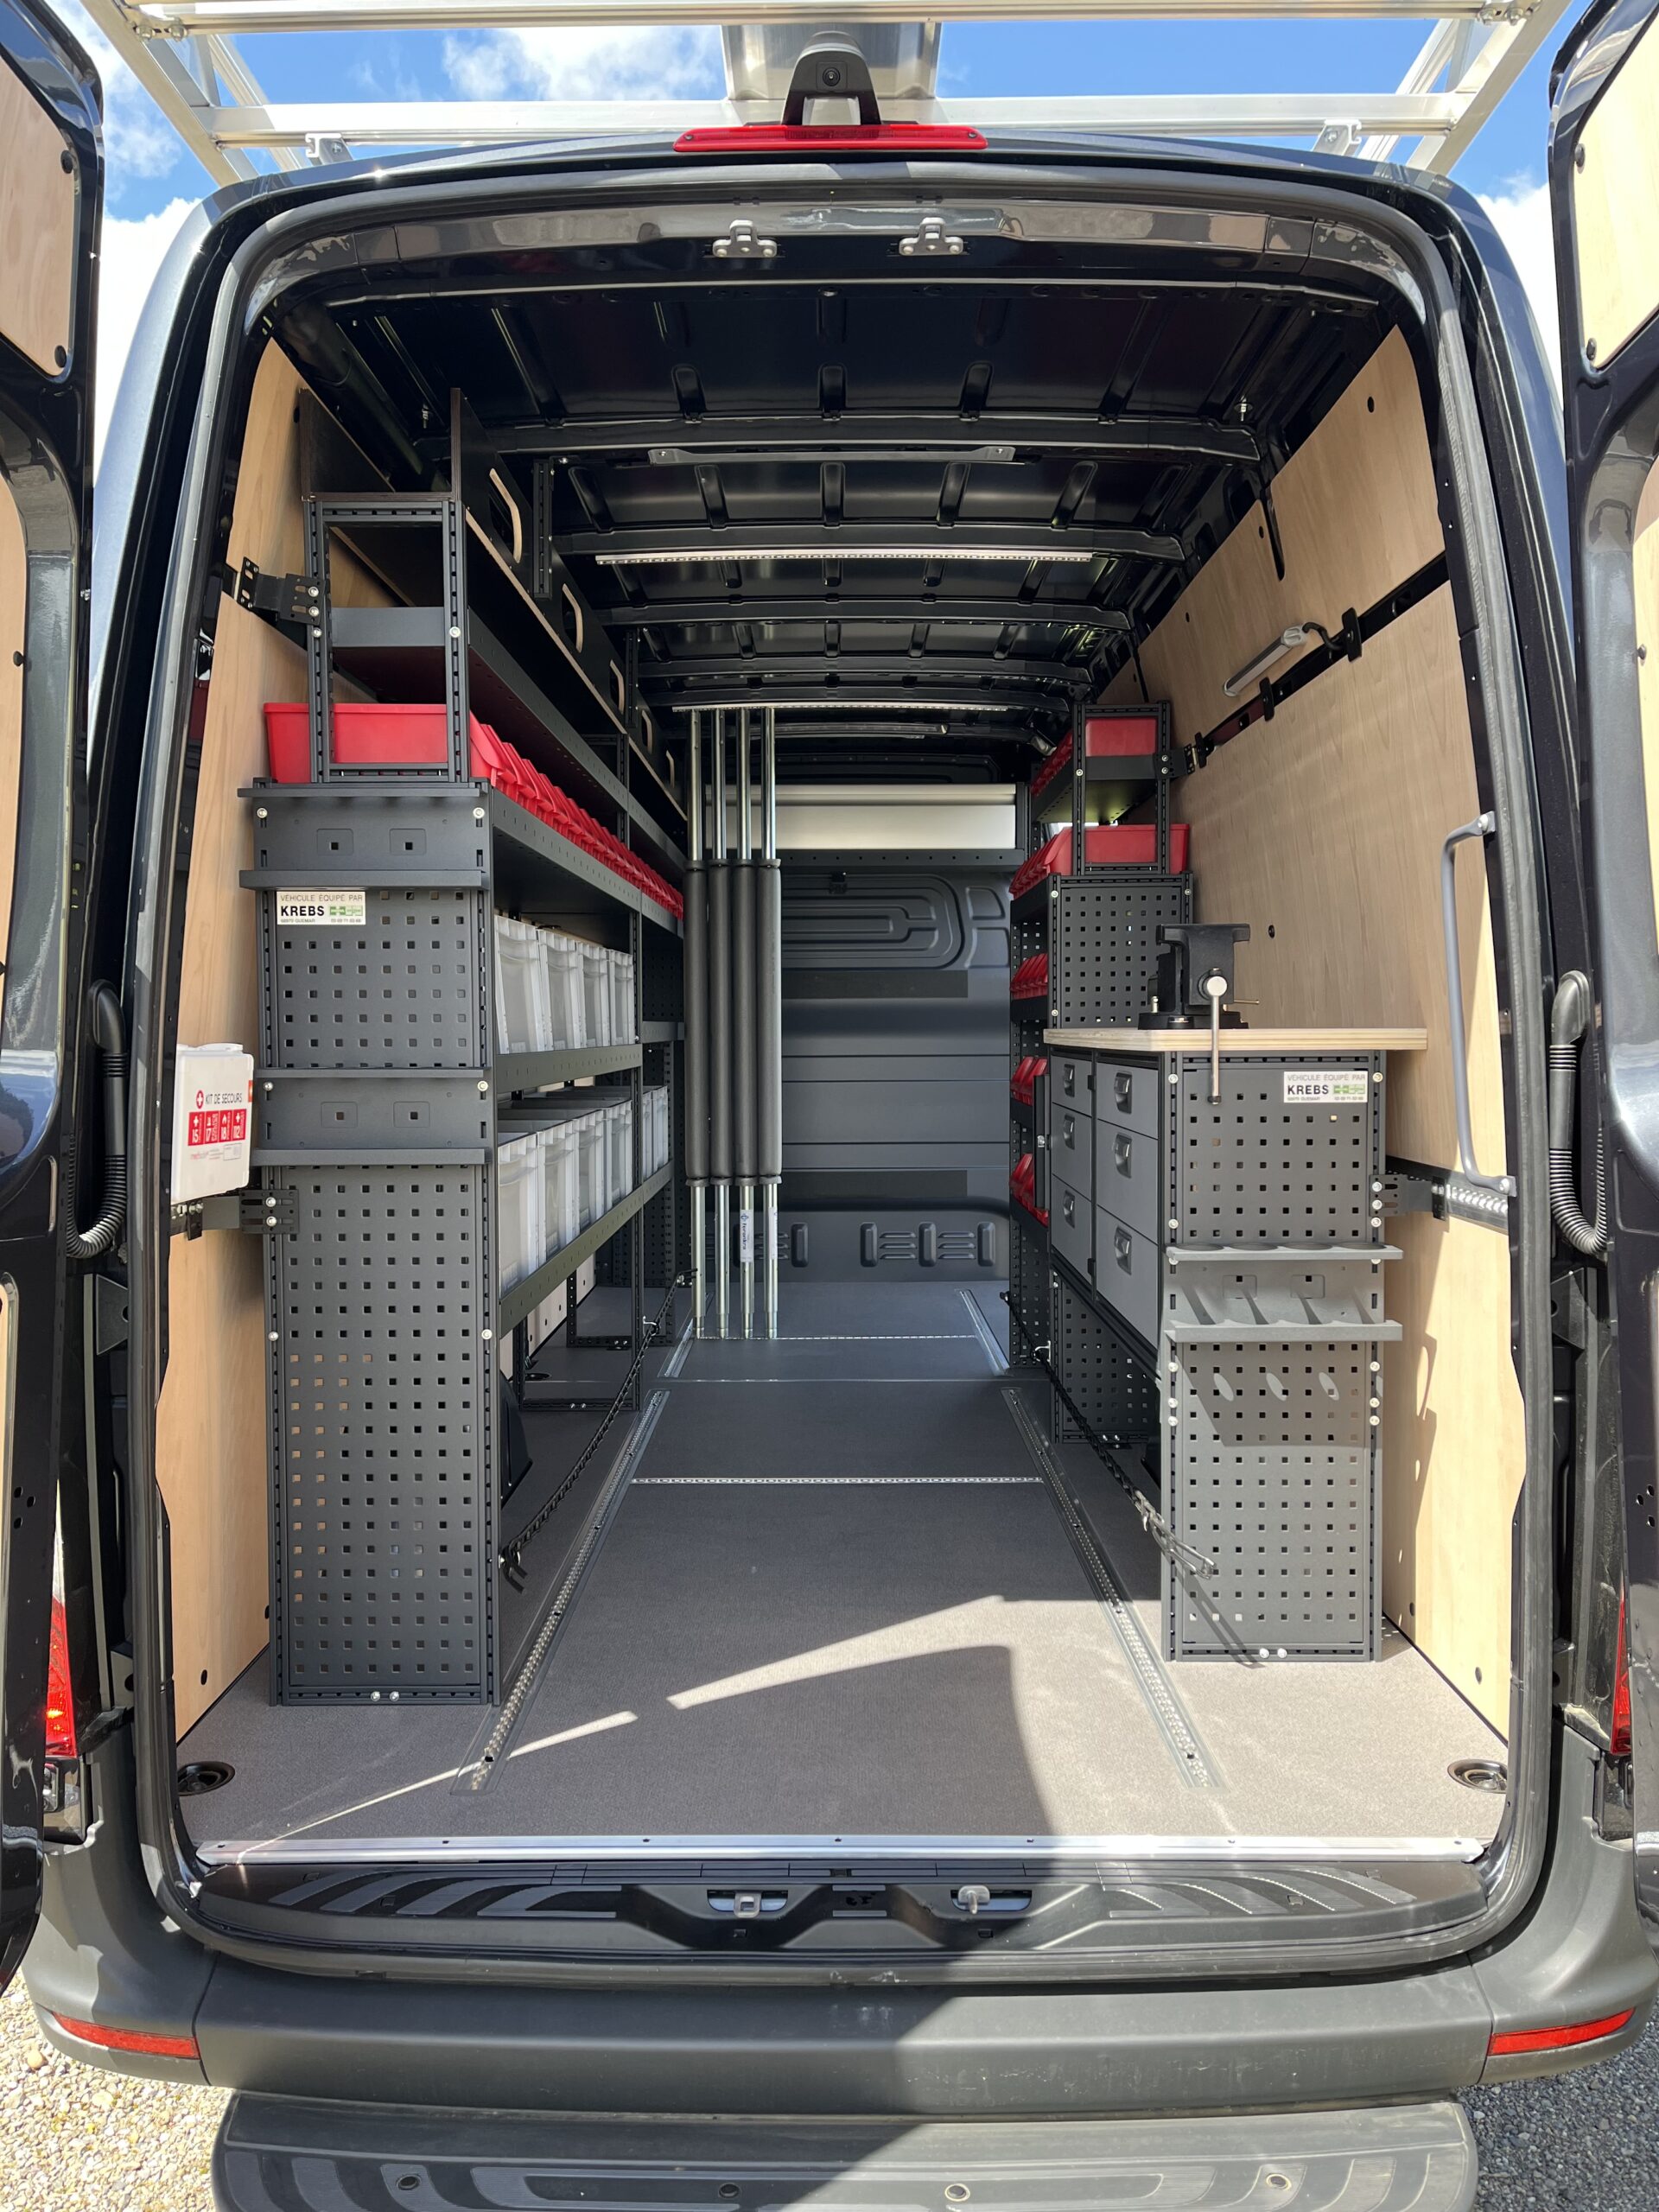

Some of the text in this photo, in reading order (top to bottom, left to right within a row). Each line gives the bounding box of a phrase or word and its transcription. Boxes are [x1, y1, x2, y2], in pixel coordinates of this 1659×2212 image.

[281, 906, 324, 916] KREBS
[1287, 1085, 1329, 1095] KREBS
[214, 1093, 221, 1104] DE
[222, 1093, 242, 1104] SECOURS
[192, 1128, 199, 1143] 15
[206, 1128, 212, 1142] 17
[221, 1126, 227, 1140] 18
